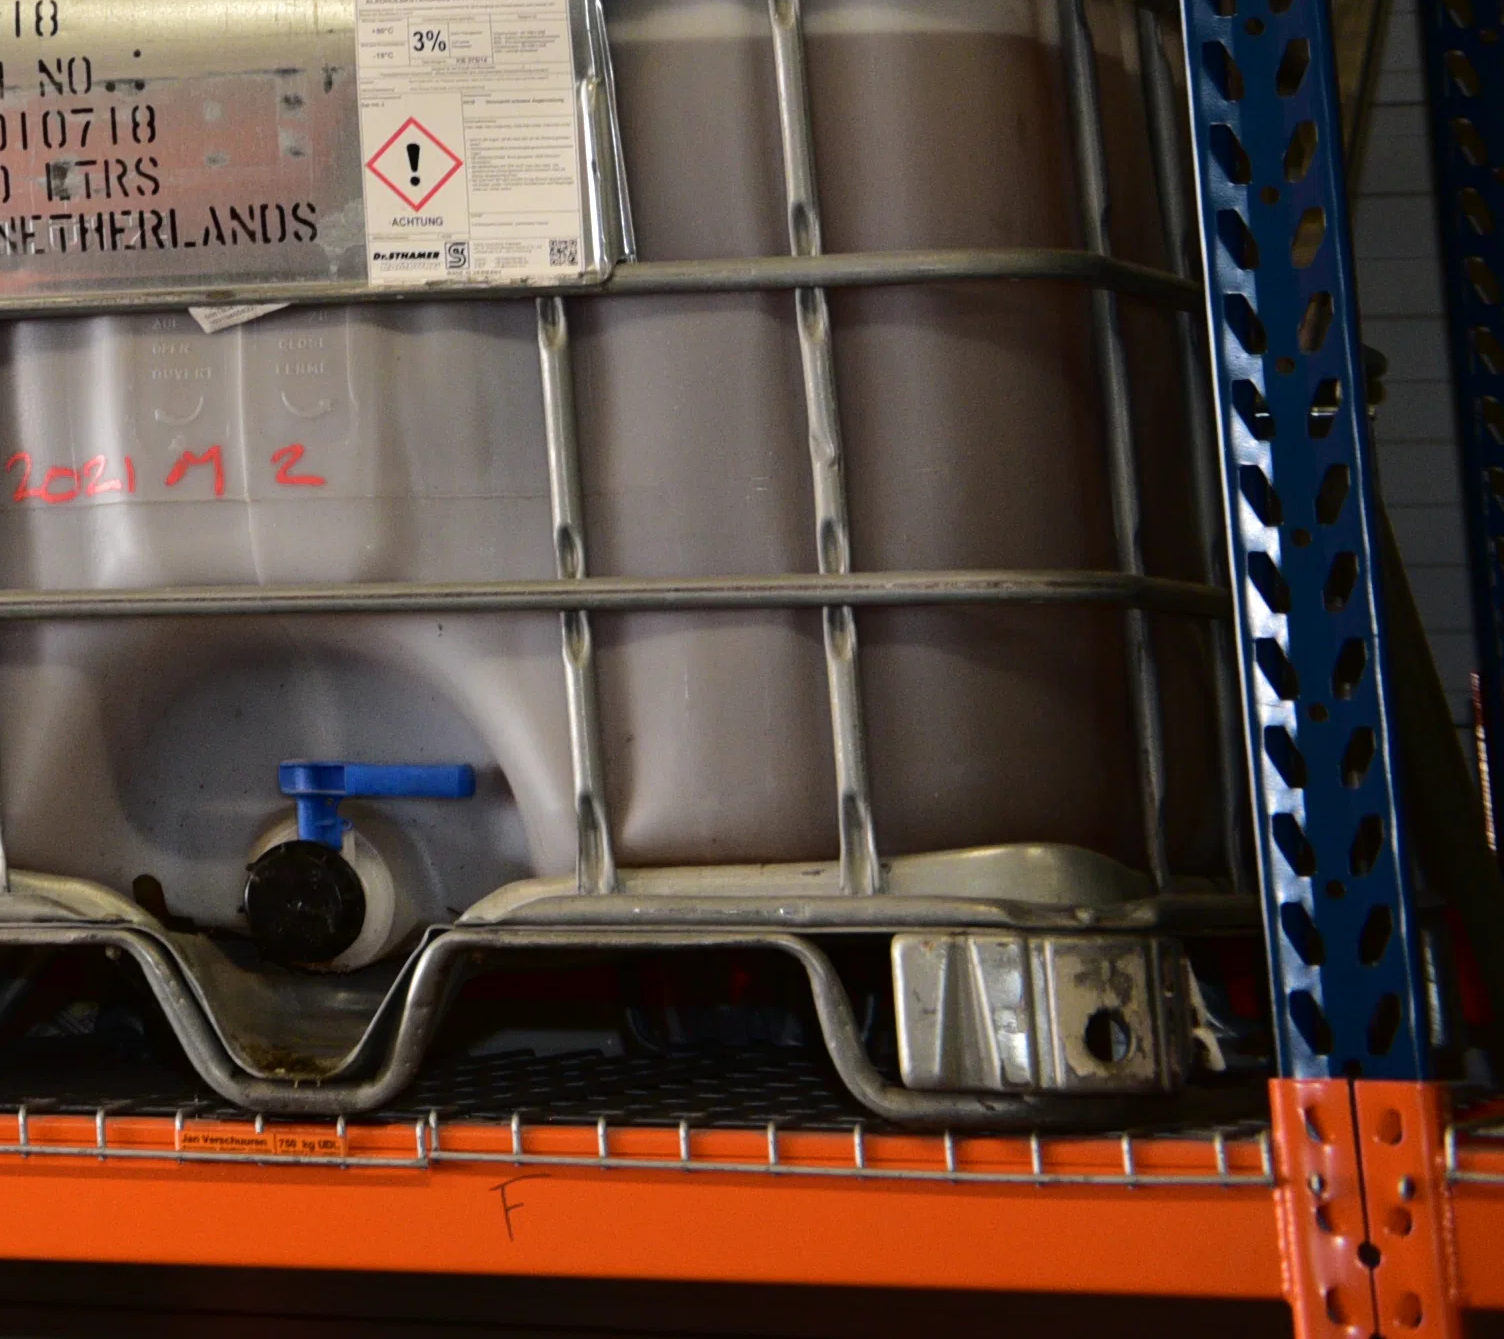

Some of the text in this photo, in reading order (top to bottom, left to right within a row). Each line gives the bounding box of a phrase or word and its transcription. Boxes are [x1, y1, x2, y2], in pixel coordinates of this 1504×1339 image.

[413, 30, 446, 52] 3%
[46, 156, 161, 203] LTRS
[391, 217, 444, 227] ACHTUNG
[4, 451, 135, 503] 2021
